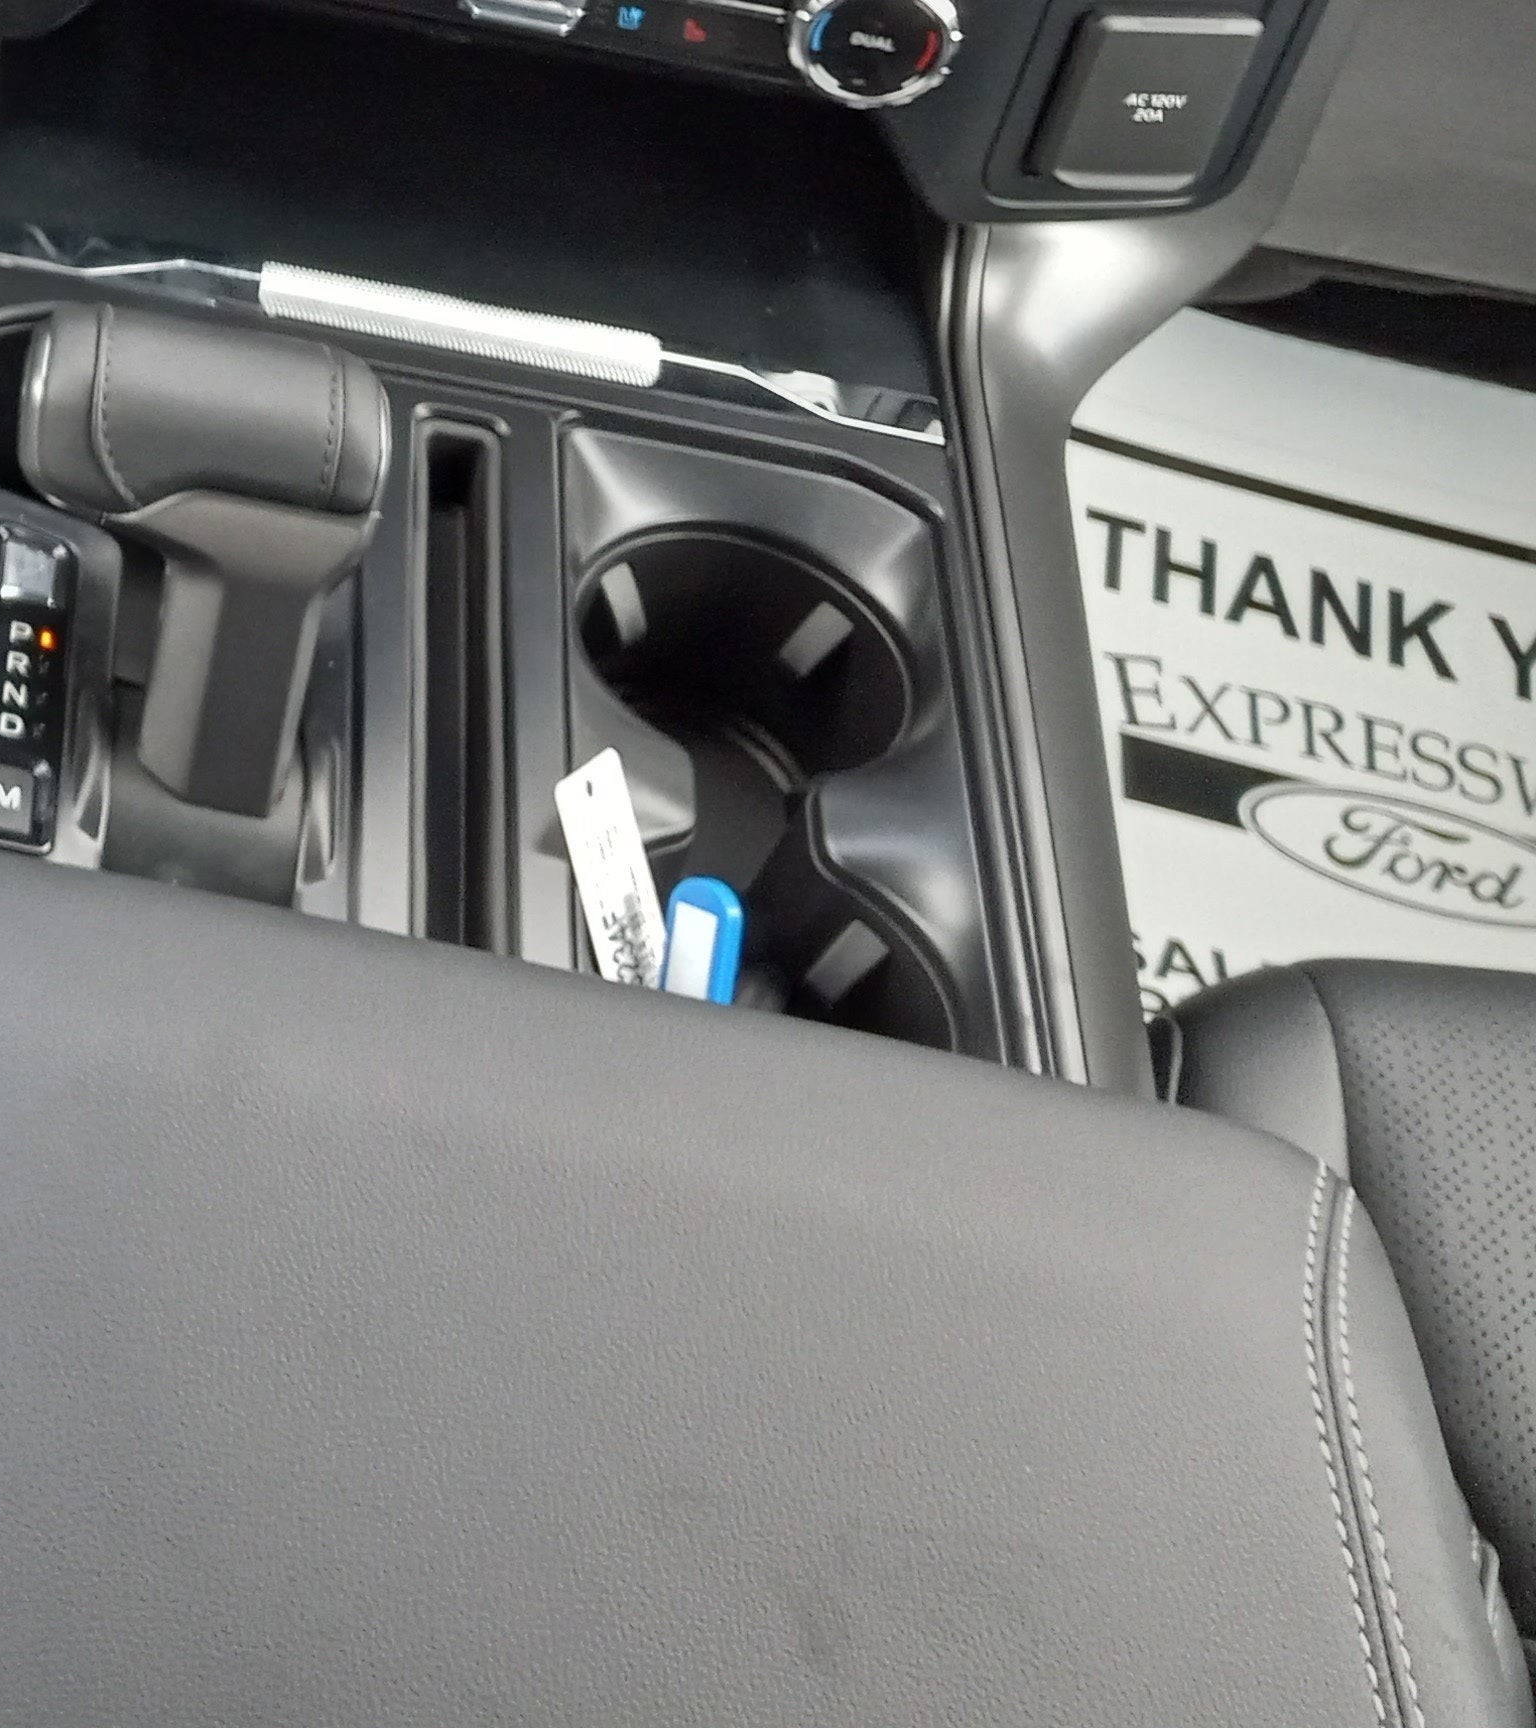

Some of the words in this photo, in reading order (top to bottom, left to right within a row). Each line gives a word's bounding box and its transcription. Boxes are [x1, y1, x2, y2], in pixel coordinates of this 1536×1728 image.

[1086, 506, 1458, 683] THANK
[1104, 649, 1536, 822] EXPRESS
[1324, 804, 1527, 912] Ford
